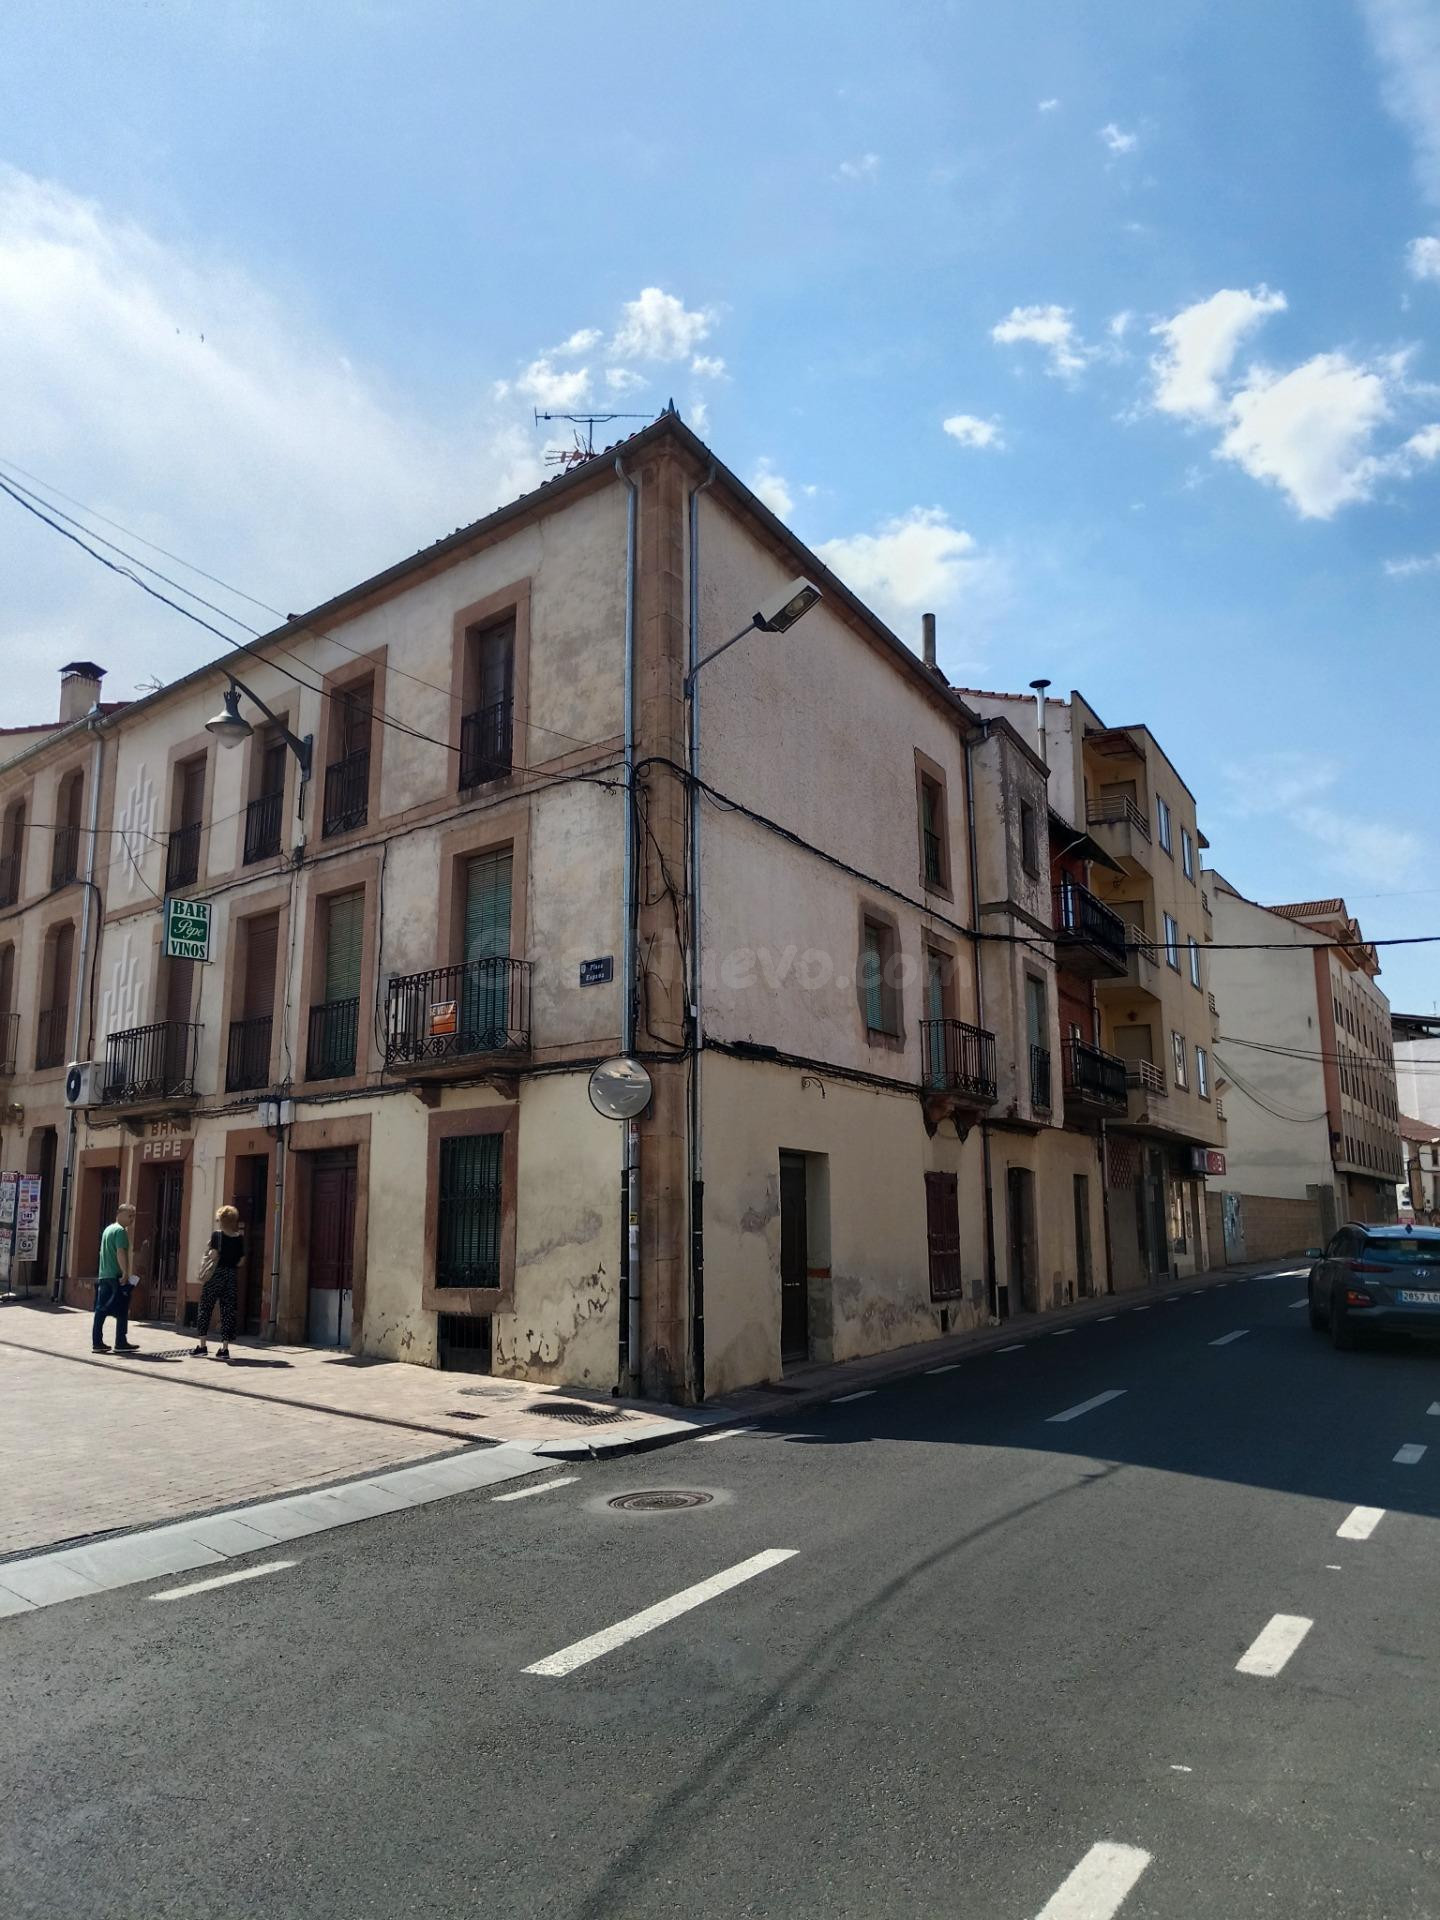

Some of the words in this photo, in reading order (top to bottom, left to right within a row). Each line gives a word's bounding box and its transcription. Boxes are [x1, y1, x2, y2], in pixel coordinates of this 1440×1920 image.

[173, 901, 207, 919] BAR
[174, 919, 205, 939] Pepe
[171, 940, 205, 958] VINOS
[151, 1121, 178, 1136] BAR
[143, 1140, 182, 1160] PEPE
